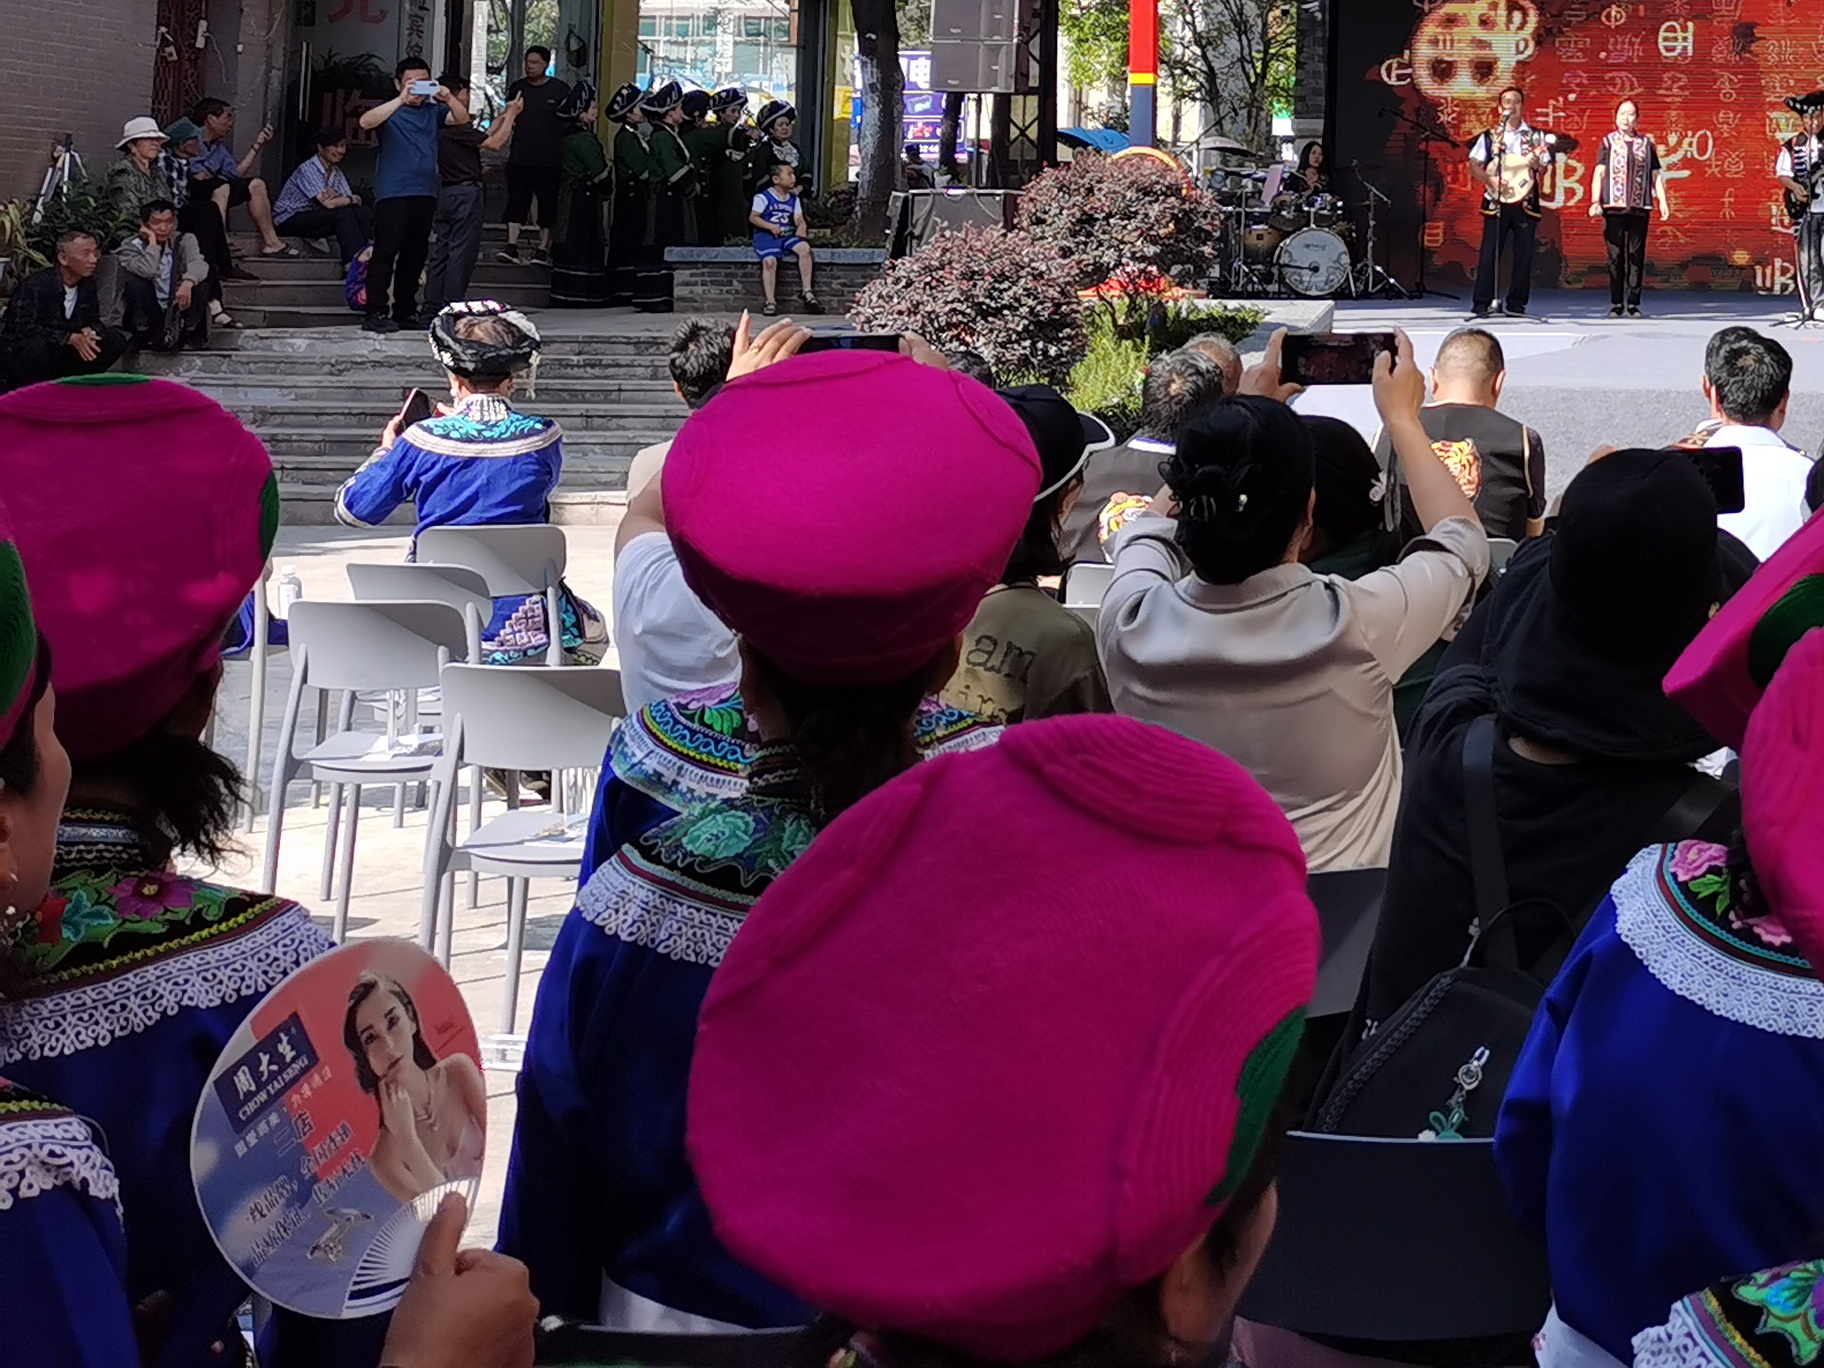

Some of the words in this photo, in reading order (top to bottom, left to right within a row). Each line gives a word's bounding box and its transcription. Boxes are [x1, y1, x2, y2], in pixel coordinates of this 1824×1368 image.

[233, 1032, 297, 1101] 周大生
[238, 1090, 269, 1121] CHOW
